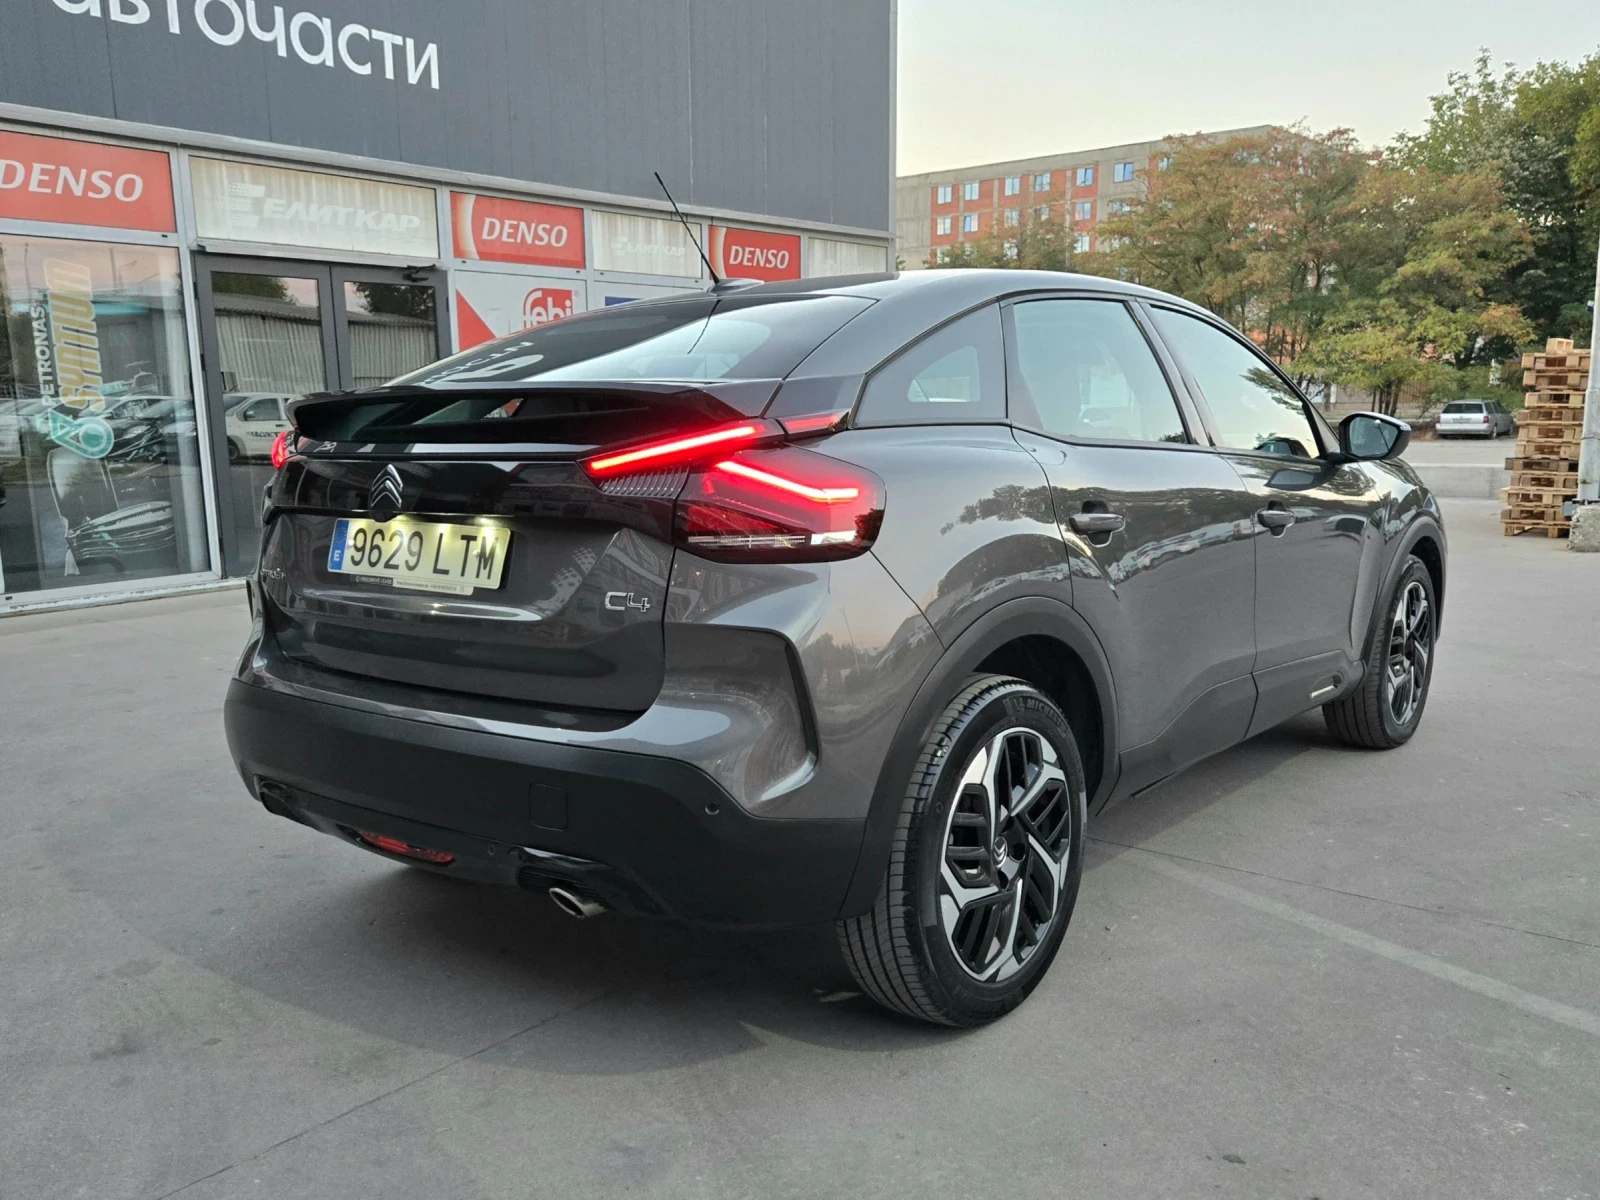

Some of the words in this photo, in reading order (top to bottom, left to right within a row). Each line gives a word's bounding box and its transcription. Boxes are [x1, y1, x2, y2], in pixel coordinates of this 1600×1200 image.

[0, 158, 144, 202] DENSO
[262, 198, 421, 232] ЕЛИТКАР
[481, 217, 568, 248] DENSO
[729, 245, 789, 270] DENSO
[30, 304, 55, 406] PETRONAS
[333, 550, 341, 561] E
[350, 527, 424, 571] 9629
[432, 532, 499, 580] LTM
[604, 591, 651, 612] C4
